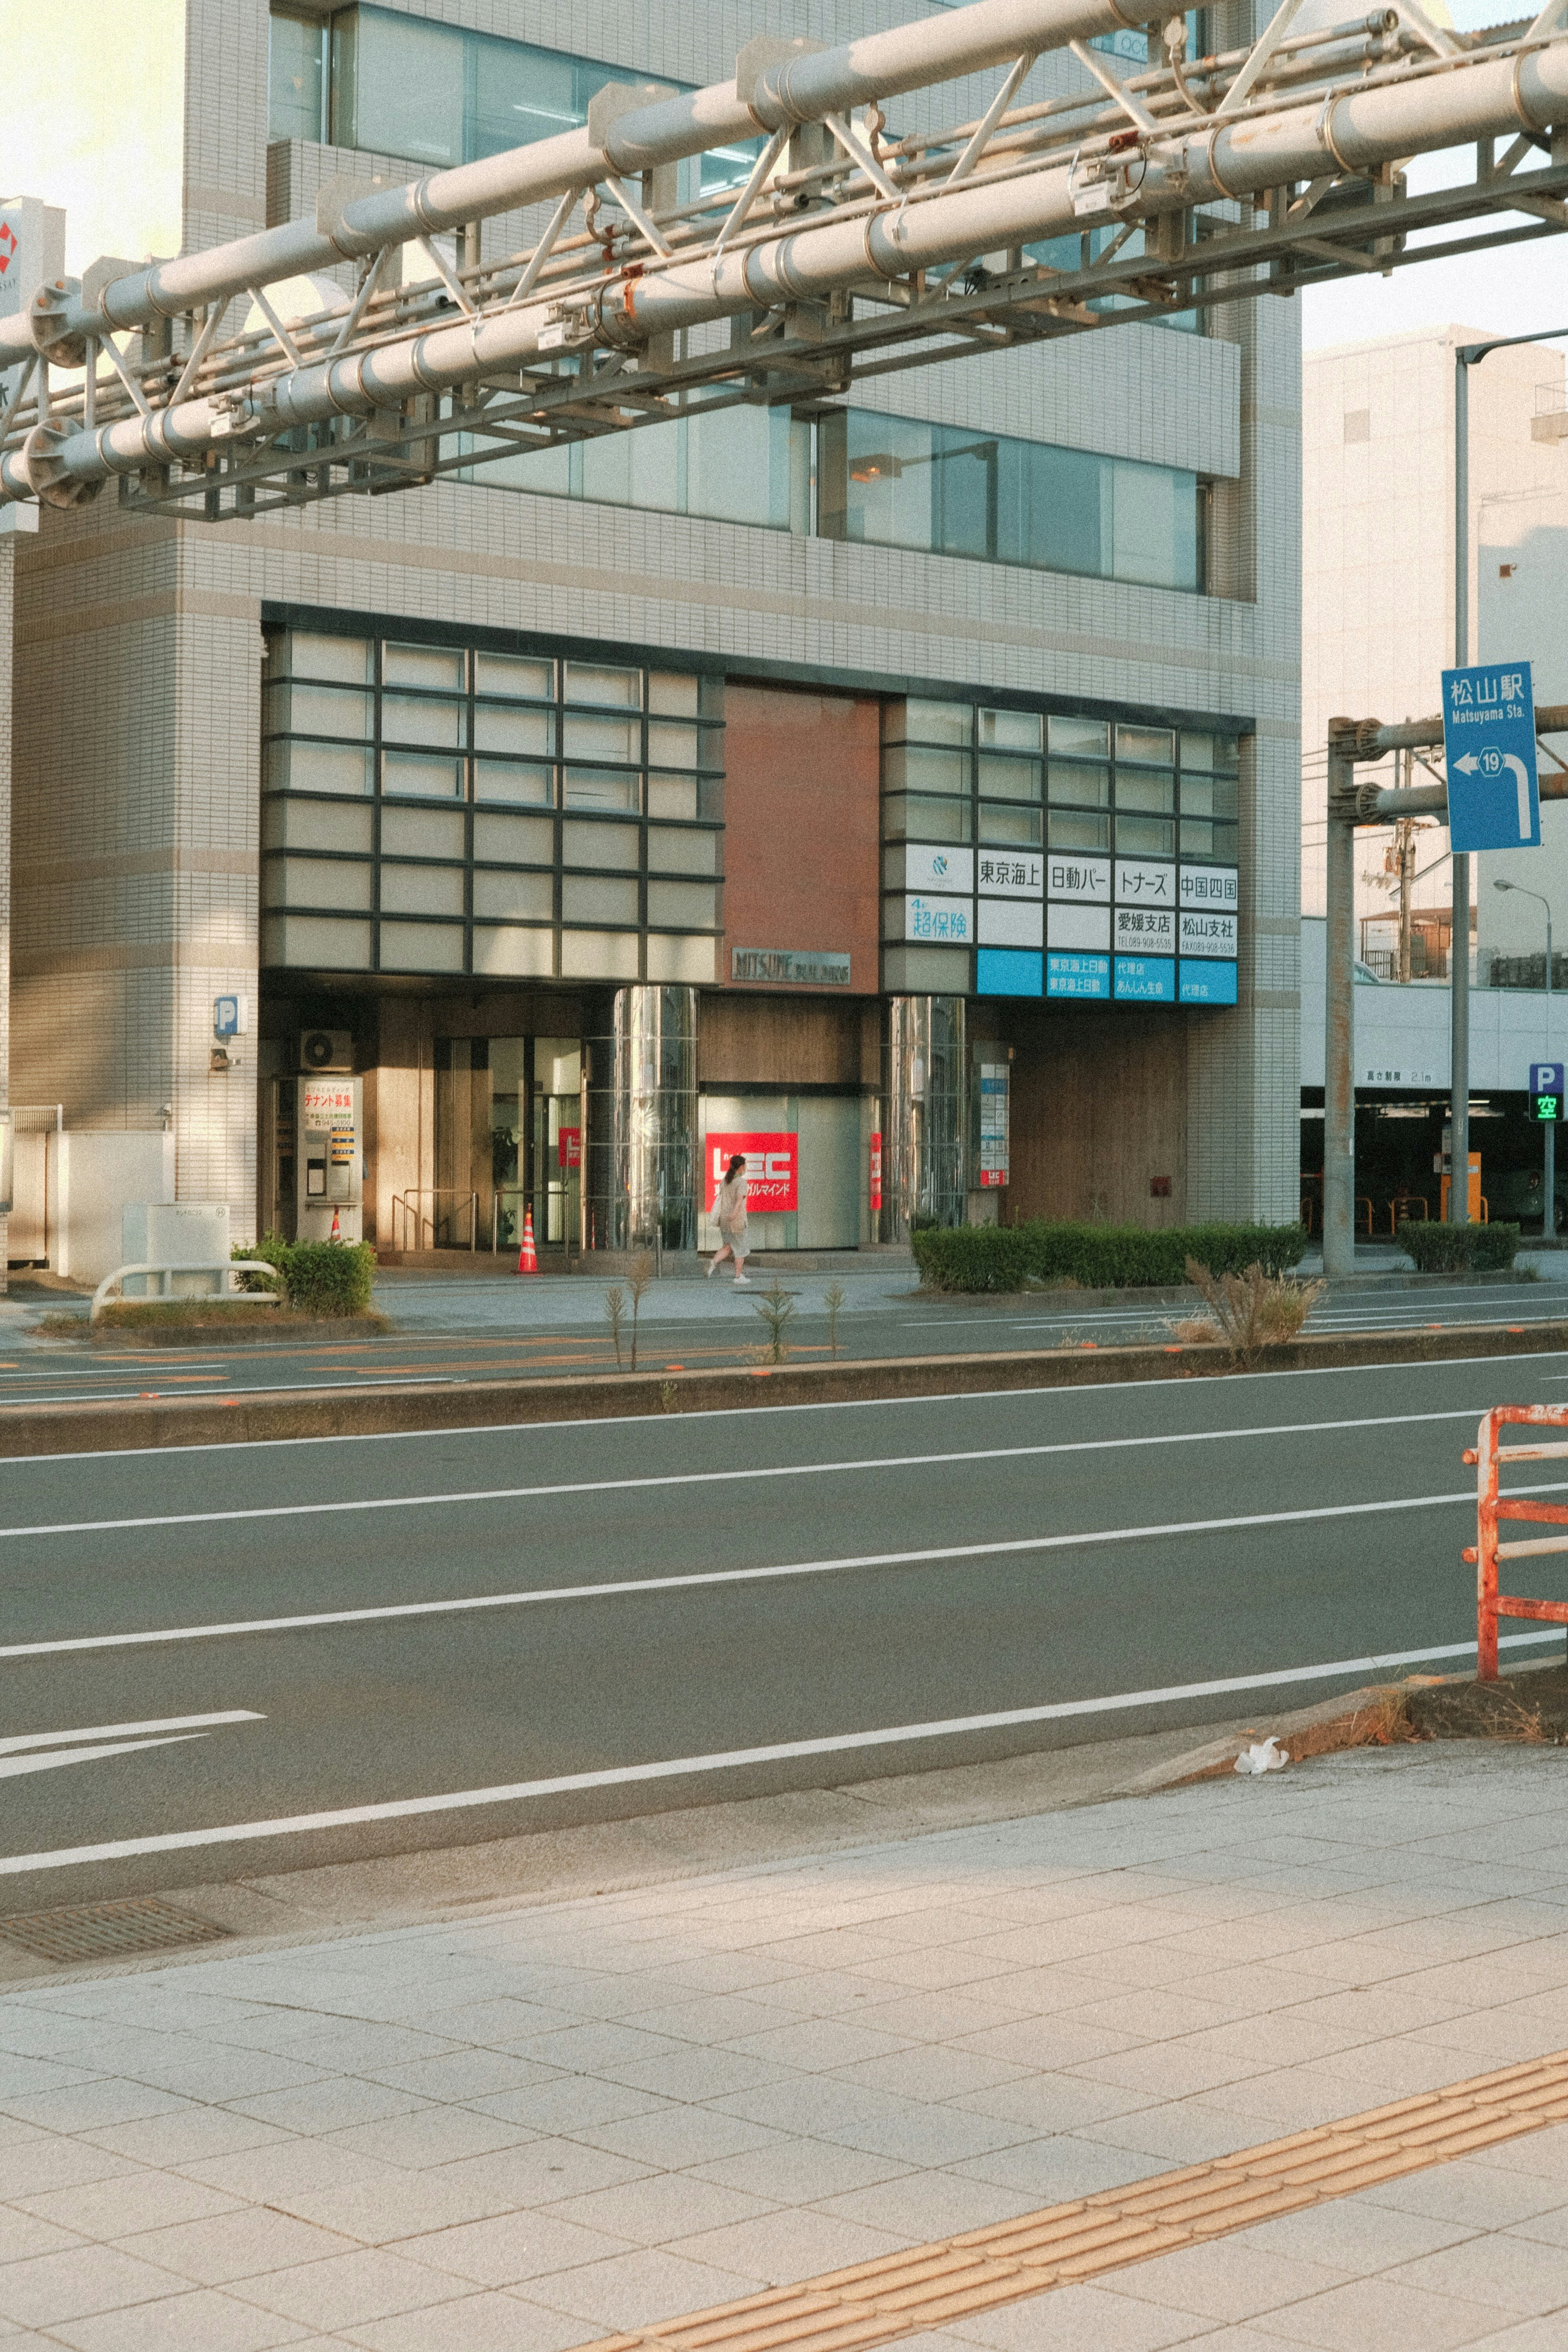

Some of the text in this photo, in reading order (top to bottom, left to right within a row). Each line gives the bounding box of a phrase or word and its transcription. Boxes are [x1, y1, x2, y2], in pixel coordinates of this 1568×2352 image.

[1451, 674, 1525, 706] 松山駅
[1453, 704, 1525, 725] Matsuyama Sta.
[1483, 753, 1499, 771] 19
[914, 912, 967, 938] 超保険
[1118, 913, 1170, 933] 愛媛支店
[1183, 917, 1233, 938] 松山支社
[219, 1001, 235, 1030] P
[1538, 1067, 1555, 1091] P
[305, 1094, 351, 1107] テナント募集
[1538, 1096, 1556, 1118] 空
